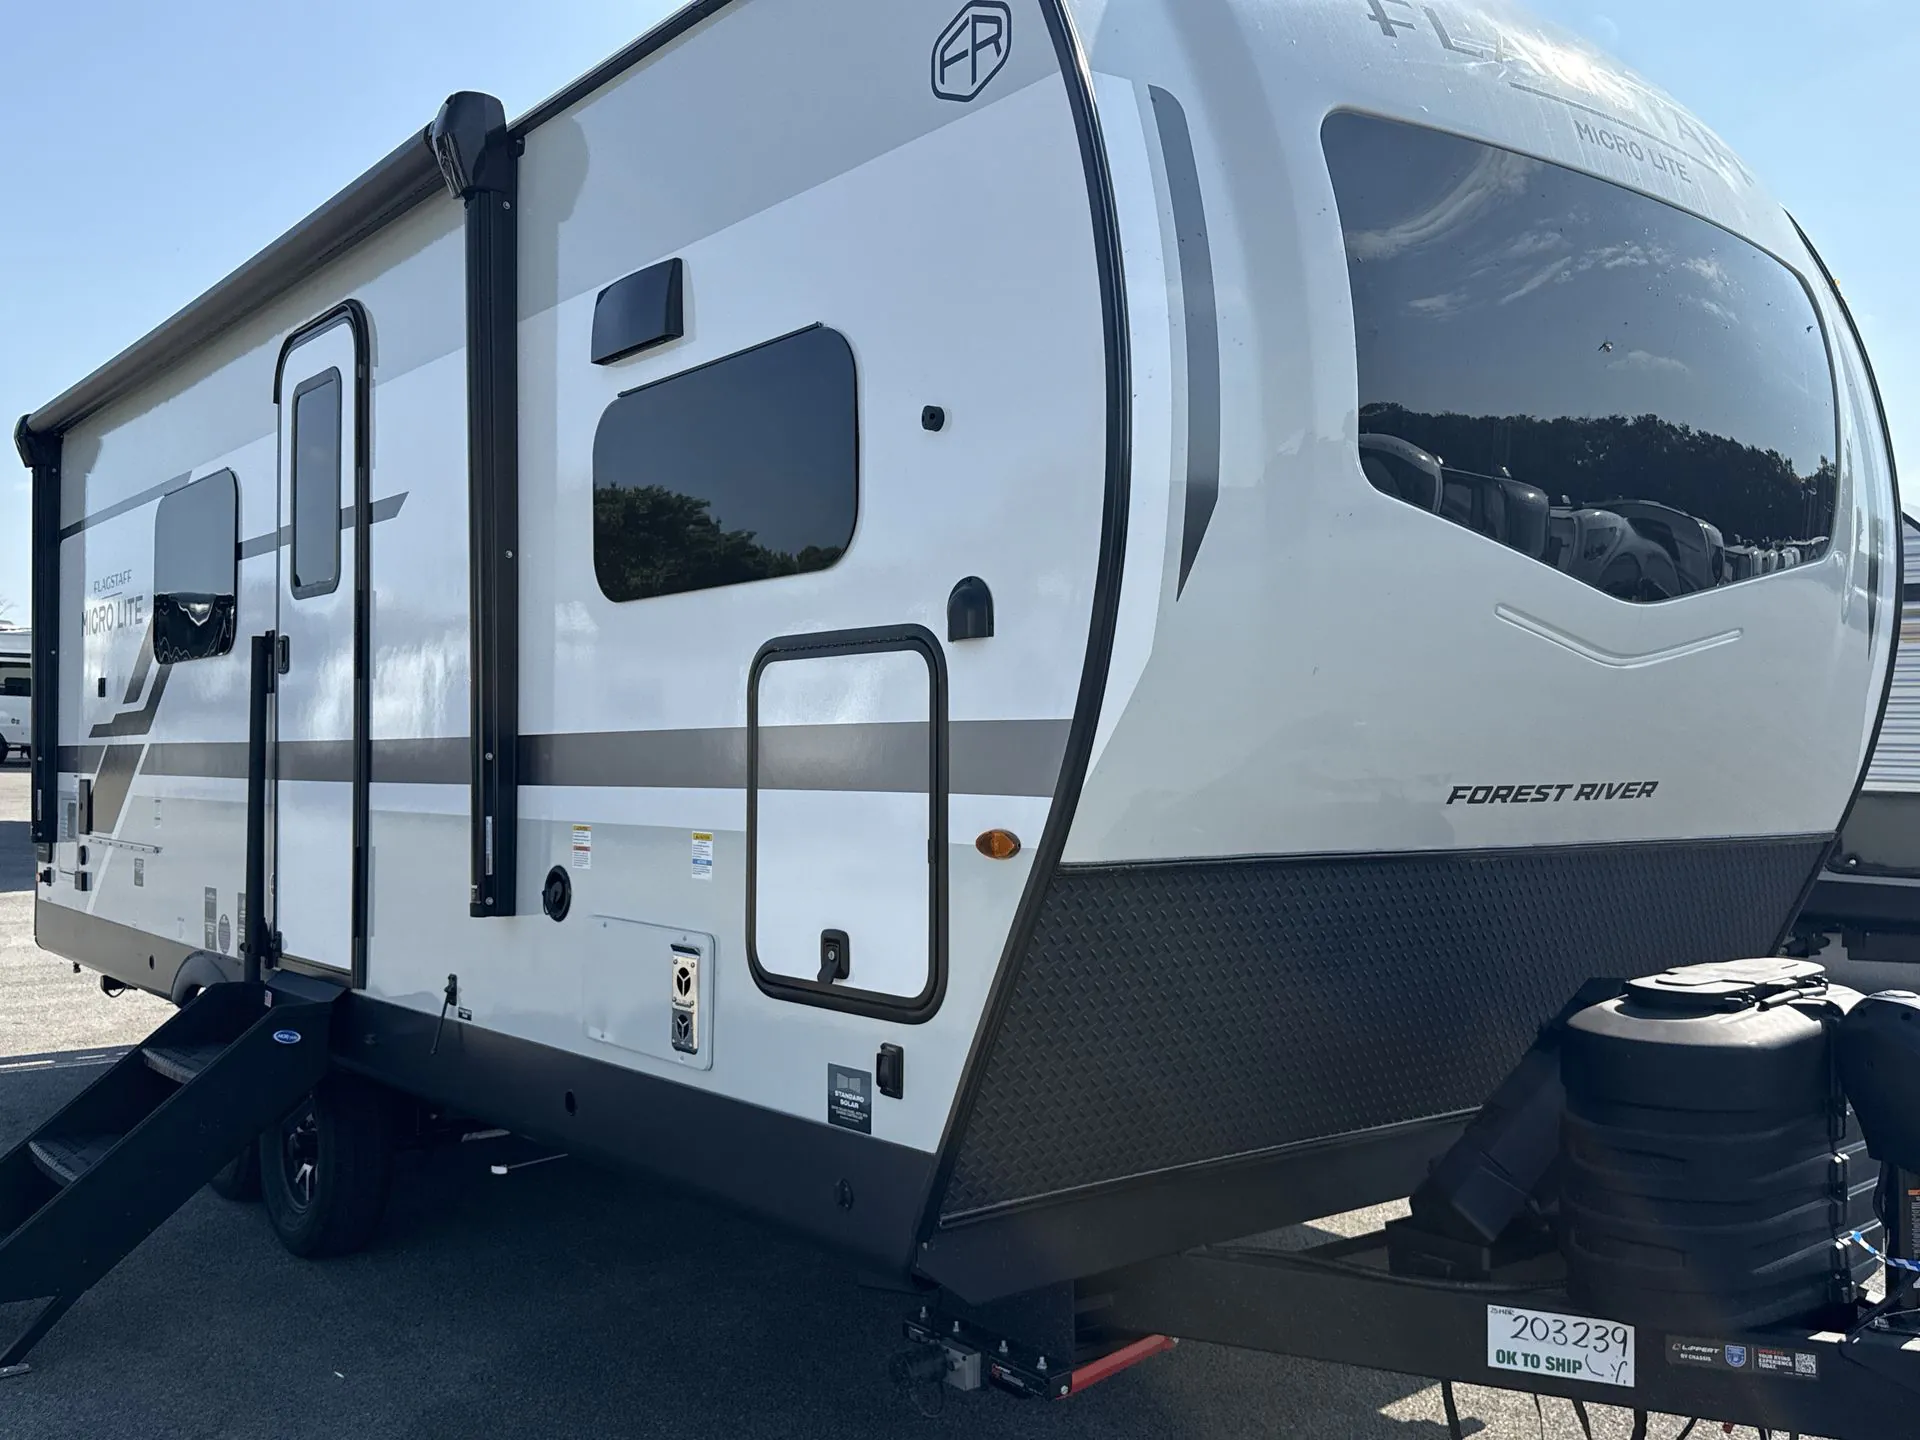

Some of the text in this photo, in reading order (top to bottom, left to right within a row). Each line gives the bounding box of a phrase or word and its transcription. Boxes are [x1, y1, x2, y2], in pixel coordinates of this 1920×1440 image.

[1574, 119, 1691, 184] MICRO LITE
[94, 569, 132, 593] FLAGSTAFF
[81, 595, 144, 637] MICRO LITE
[1446, 781, 1659, 804] FOREST RIVER
[835, 1090, 864, 1103] STANDARD
[840, 1099, 859, 1109] SOLAR
[1510, 1315, 1627, 1357] 203239
[1495, 1349, 1583, 1374] OK TO SHIP
